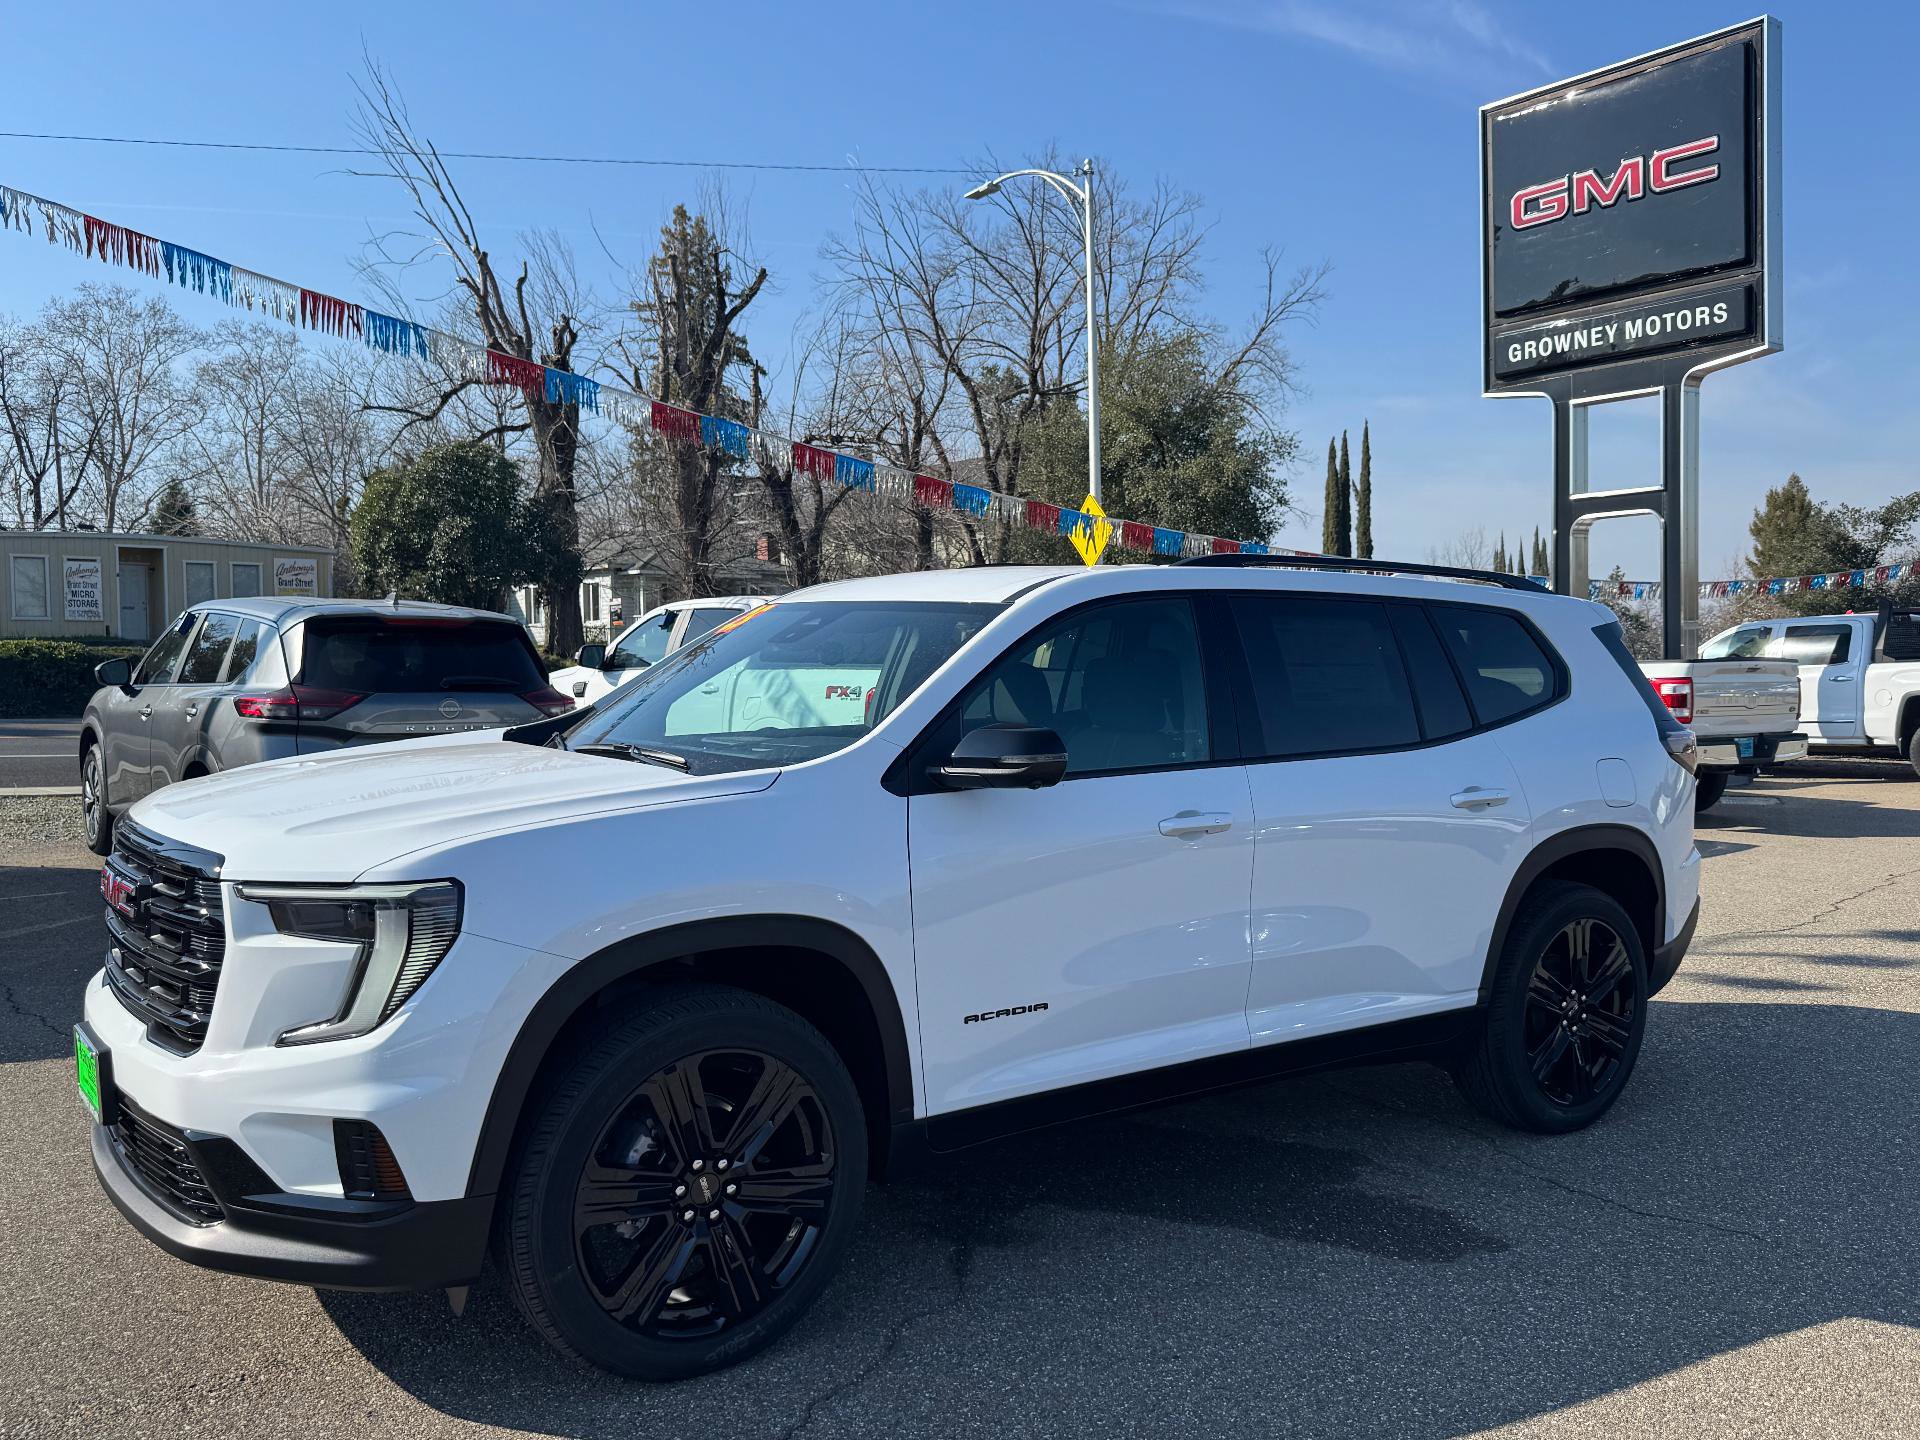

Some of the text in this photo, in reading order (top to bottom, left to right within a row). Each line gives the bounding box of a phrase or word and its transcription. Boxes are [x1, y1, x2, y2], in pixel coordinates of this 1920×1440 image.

[1510, 134, 1719, 230] GMC
[1508, 302, 1728, 363] GROWNEY MOTORS
[276, 560, 315, 577] Anthony's
[82, 580, 98, 589] Street
[278, 577, 314, 588] Grant Street
[71, 590, 95, 599] MICRO
[67, 599, 99, 608] STORAGE
[825, 685, 863, 700] FX4
[964, 1002, 1049, 1024] ACADIA
